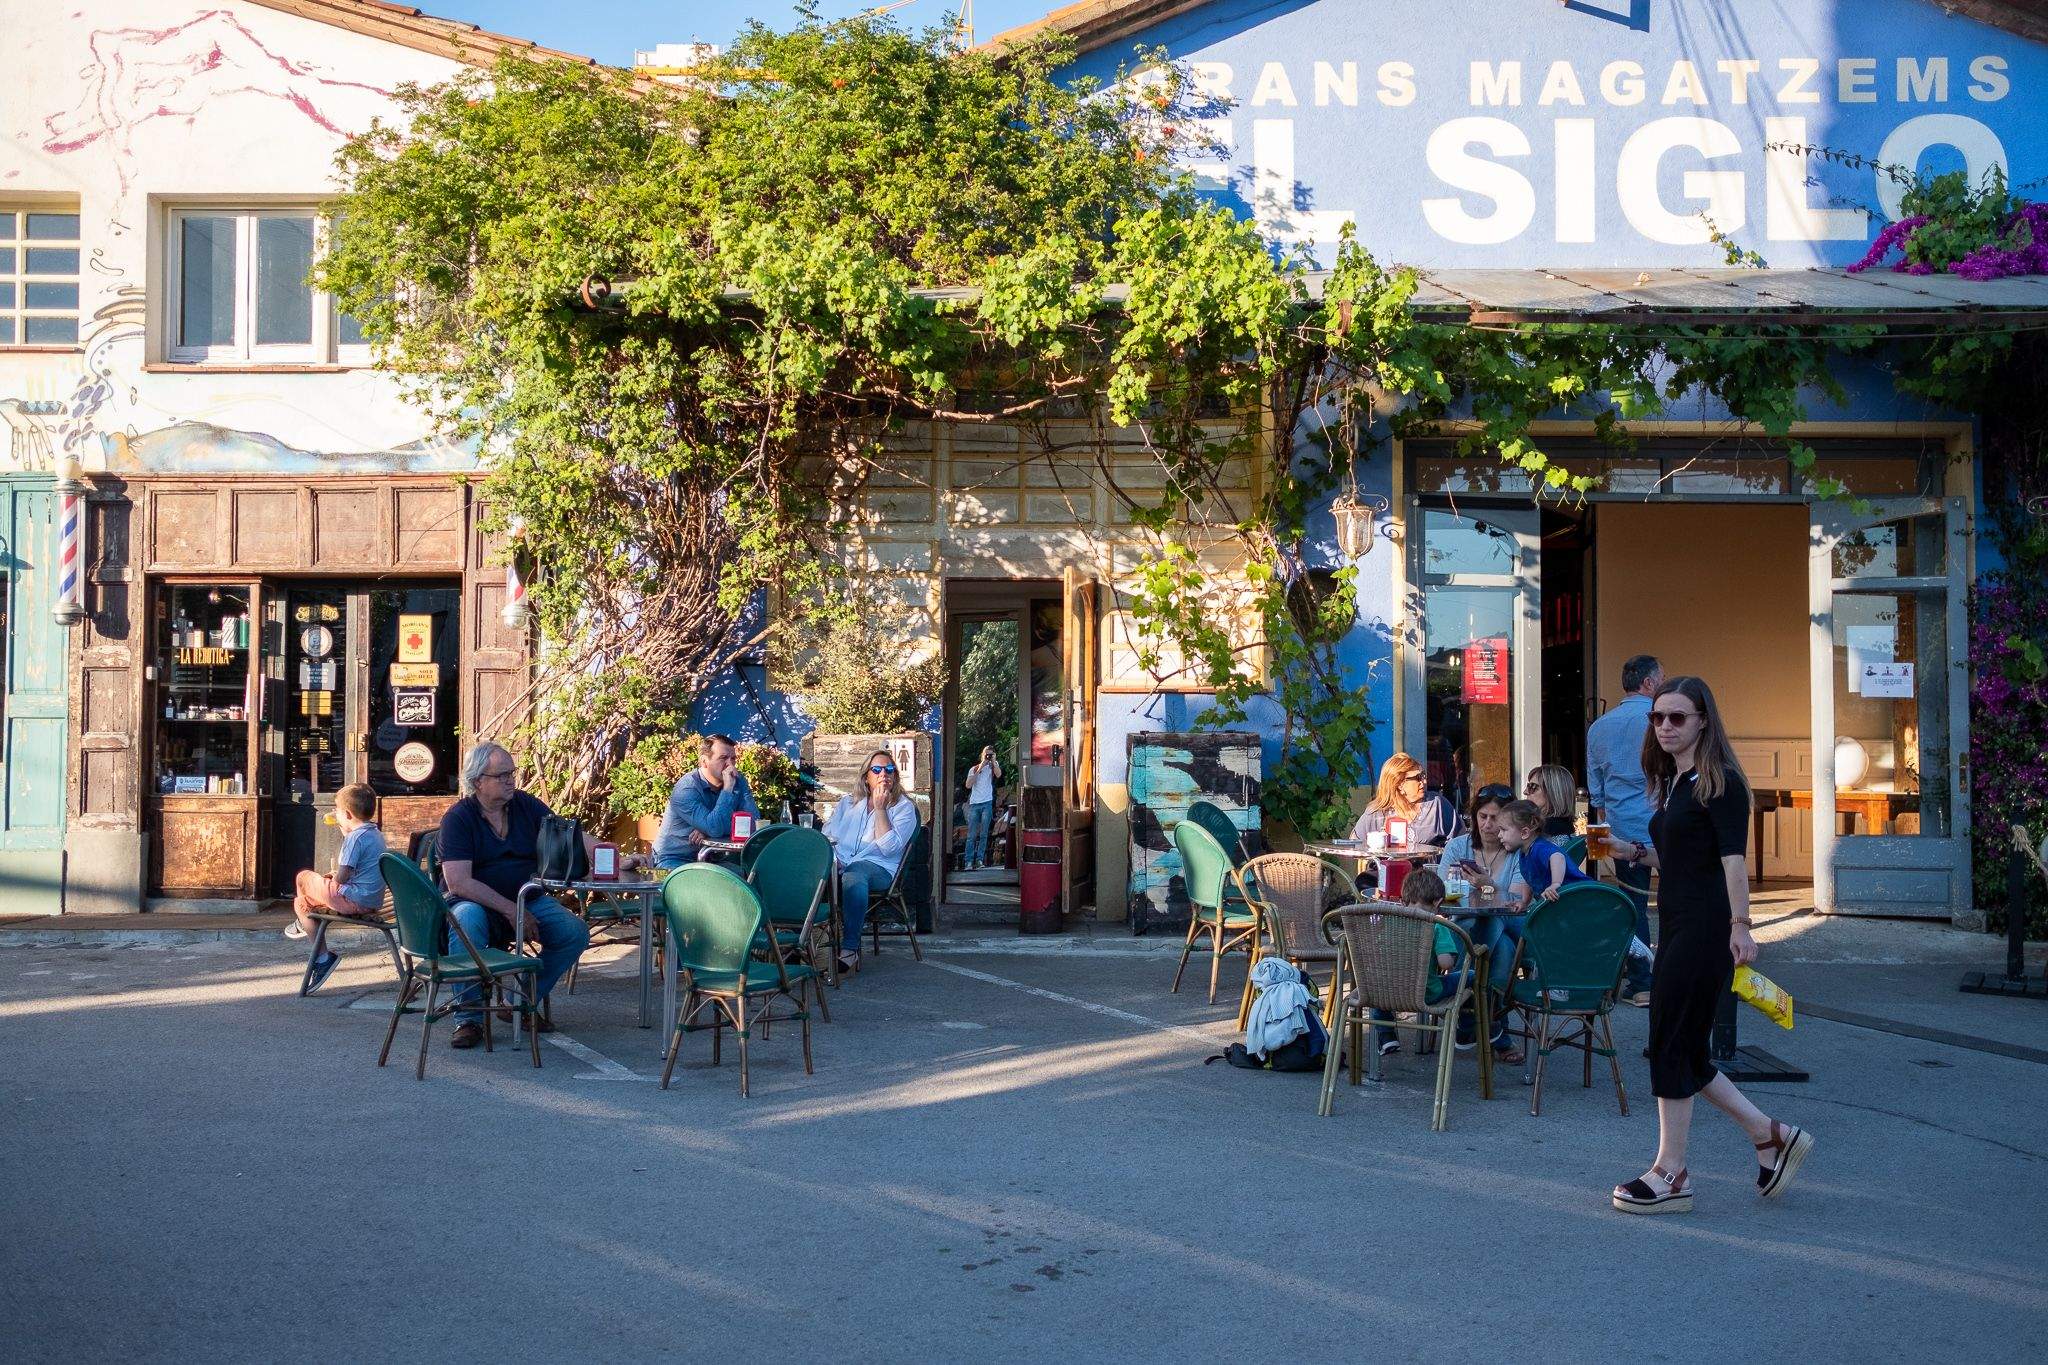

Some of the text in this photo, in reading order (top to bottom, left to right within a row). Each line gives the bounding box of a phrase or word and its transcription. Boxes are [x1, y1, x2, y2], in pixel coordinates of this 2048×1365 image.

[1470, 56, 2010, 107] MAGATZEMS
[1421, 113, 2010, 246] SIGLO
[180, 647, 229, 664] LA REBOTIGA
